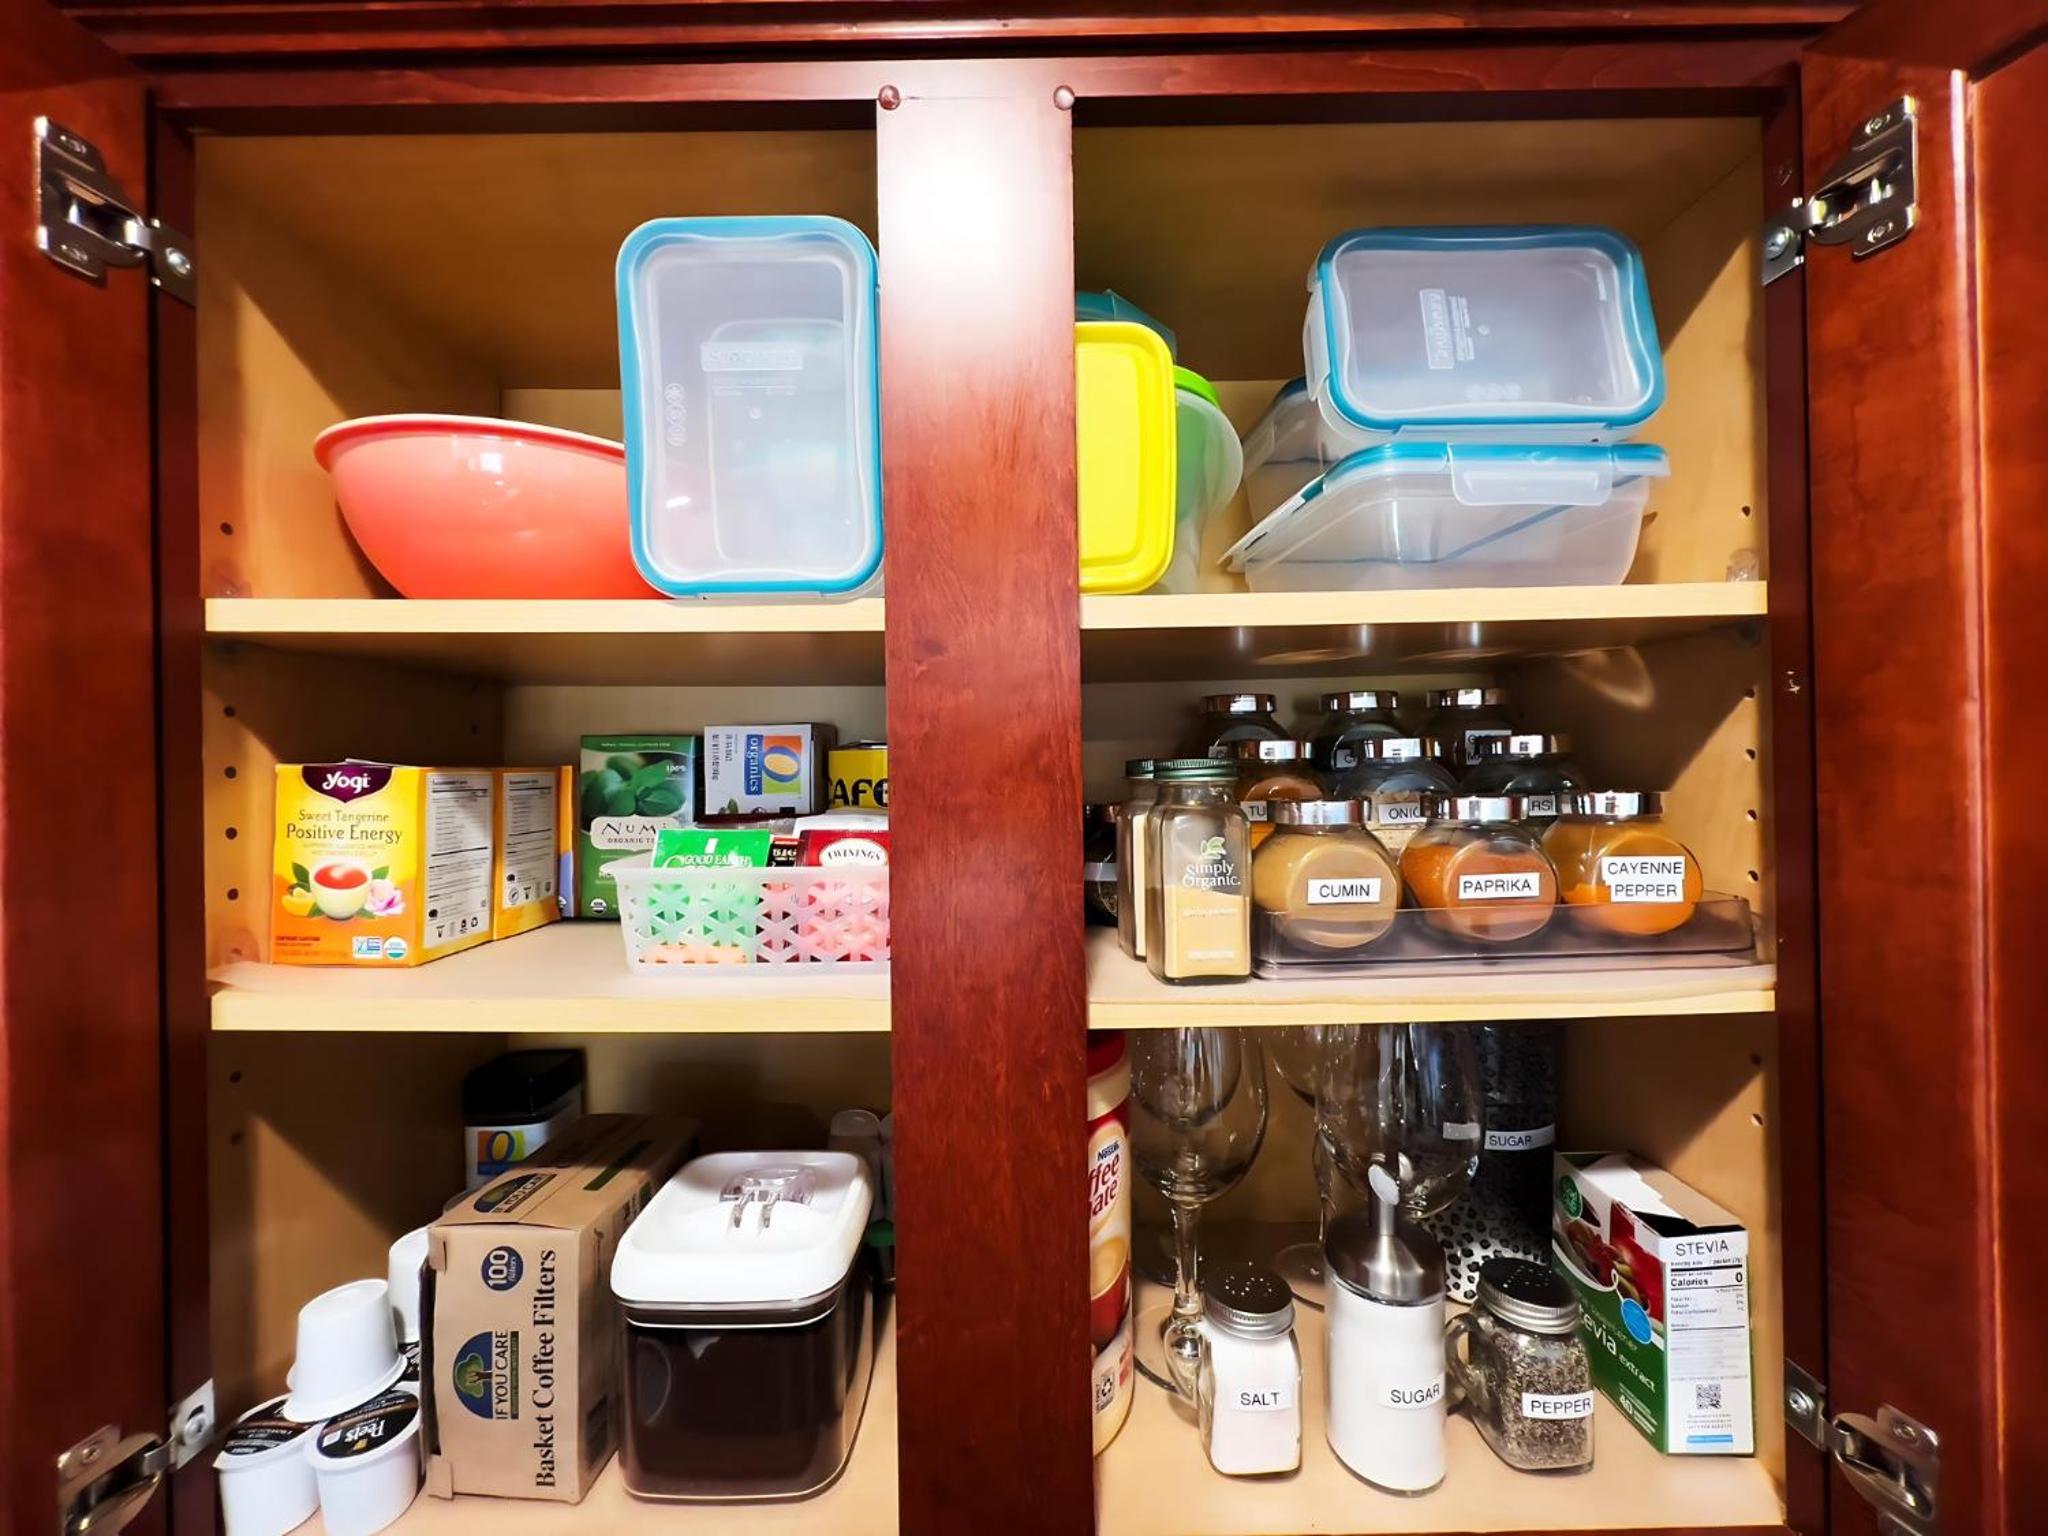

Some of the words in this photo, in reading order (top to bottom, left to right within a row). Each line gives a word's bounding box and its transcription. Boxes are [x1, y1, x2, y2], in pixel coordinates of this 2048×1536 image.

[748, 737, 761, 792] organics
[322, 771, 369, 793] yogi
[299, 809, 331, 821] Sweet
[335, 810, 389, 823] Tangerine
[286, 823, 345, 839] Positive
[350, 825, 402, 844] Energy
[685, 855, 713, 865] GOOD
[1607, 862, 1683, 876] CAYENNE
[1319, 883, 1371, 898] CUMIN
[1462, 878, 1532, 893] PAPRIKA
[1614, 883, 1678, 898] PEPPER
[1489, 1135, 1532, 1147] SUGAR
[1675, 1239, 1729, 1257] STEVIA
[488, 1249, 509, 1287] 100
[1671, 1277, 1709, 1287] Calories
[1735, 1271, 1743, 1283] 0
[533, 1249, 556, 1328] Filters
[494, 1330, 508, 1371] CARE
[533, 1333, 555, 1409] Coffee
[494, 1374, 508, 1406] YOU
[1240, 1391, 1280, 1406] SALT
[1390, 1385, 1440, 1404] SUGAR
[494, 1408, 508, 1420] IF
[1530, 1397, 1591, 1414] PEPPER
[534, 1415, 556, 1487] Basket
